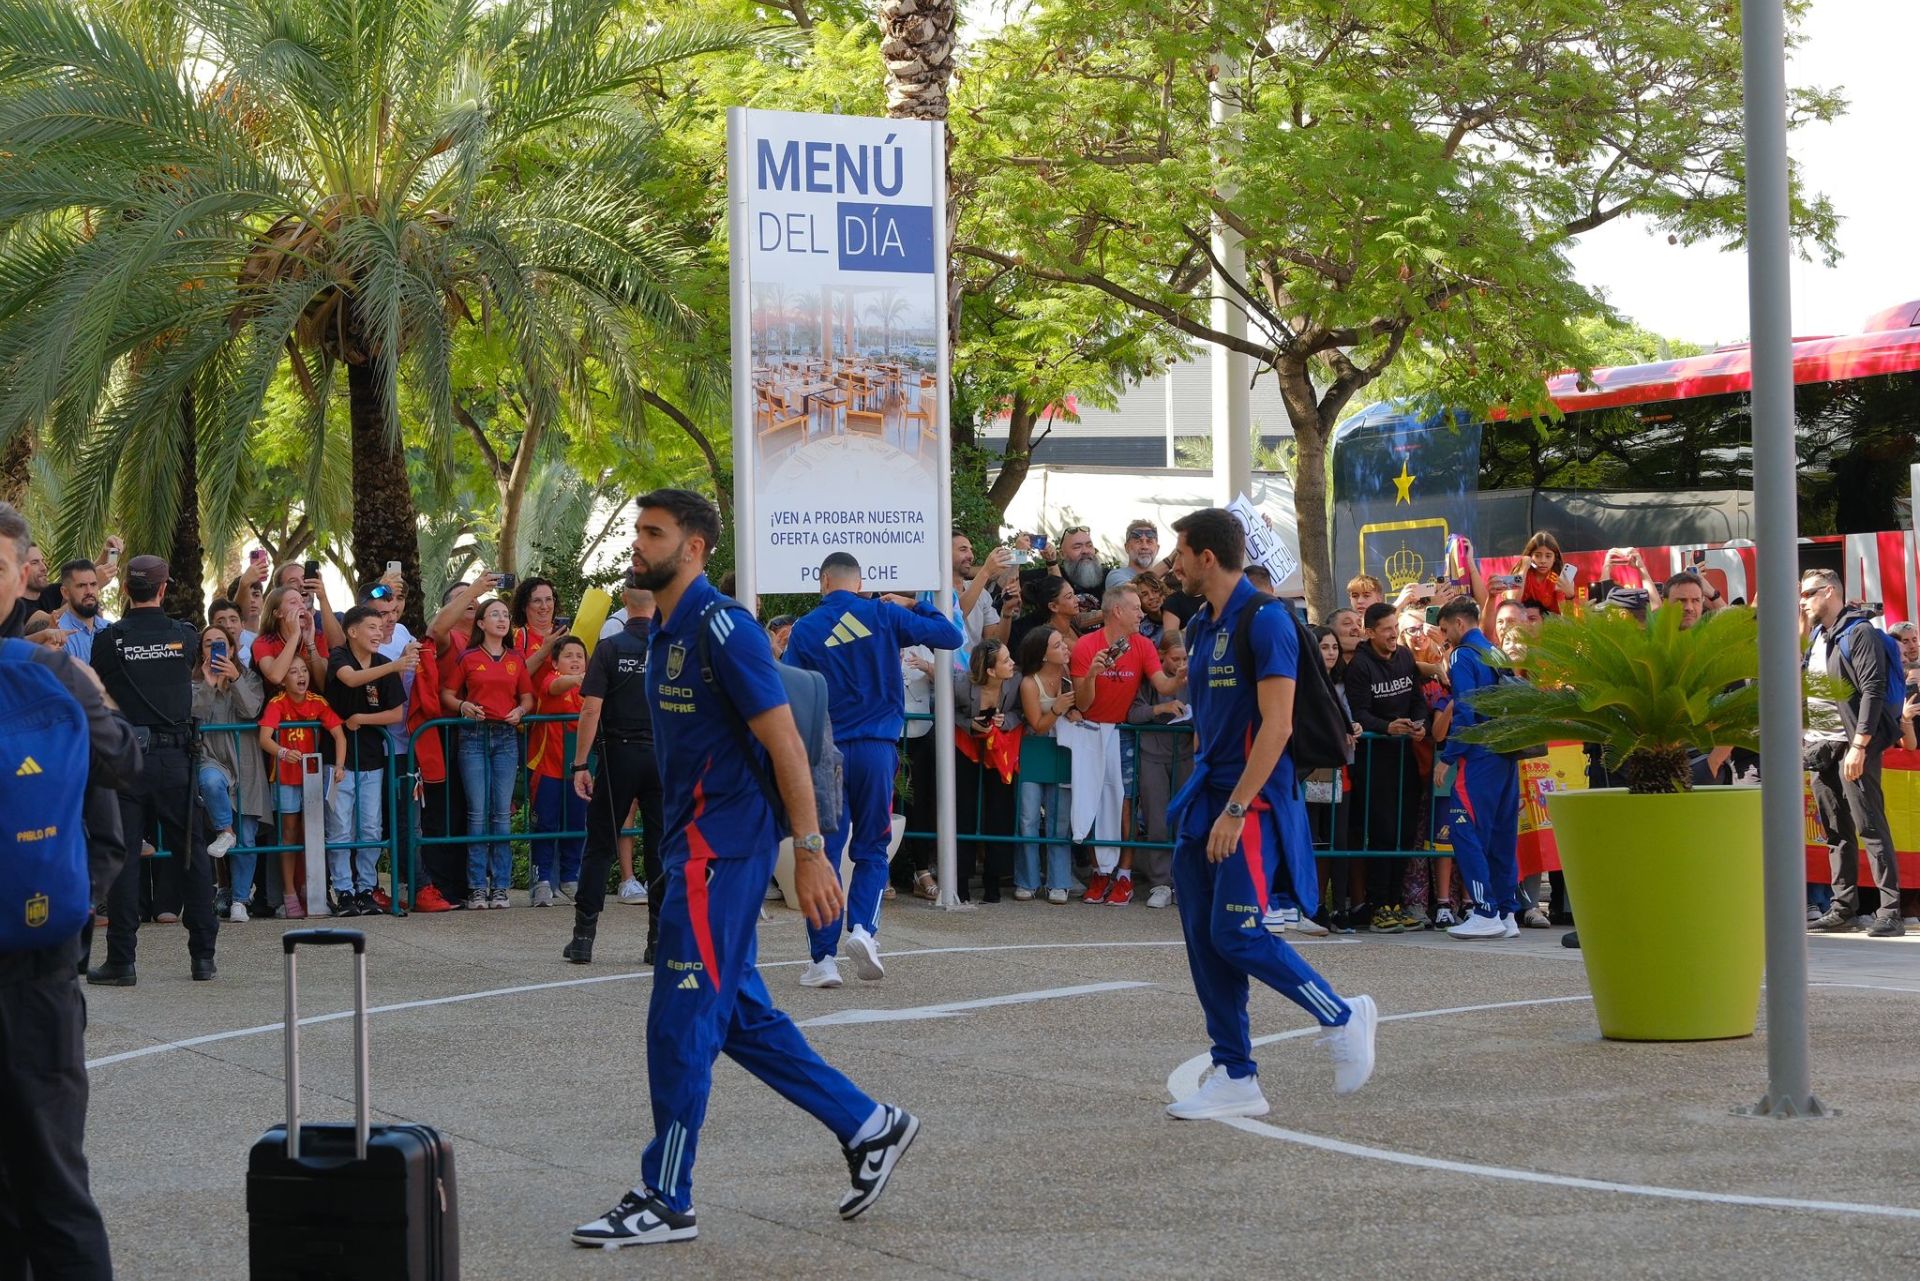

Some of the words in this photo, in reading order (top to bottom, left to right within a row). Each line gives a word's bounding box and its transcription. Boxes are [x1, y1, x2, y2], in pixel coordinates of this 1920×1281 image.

[757, 133, 904, 197] MENÚ
[759, 211, 829, 254] DEL
[844, 206, 905, 257] DÍA
[770, 511, 799, 527] ¡VEN
[802, 511, 812, 525] A
[815, 511, 865, 525] PROBAR
[868, 510, 925, 525] NUESTRA
[770, 532, 819, 545] OFERTA
[822, 528, 925, 545] GASTRONÓMICA!
[801, 567, 821, 582] PO
[861, 565, 898, 581] LCHE
[124, 643, 172, 654] POLICIA
[125, 650, 184, 660] NACIONAL
[658, 684, 693, 698] EBRO
[1371, 676, 1413, 694] ULL&BEA
[1226, 903, 1259, 913] EBRO
[667, 959, 704, 971] EBRO
